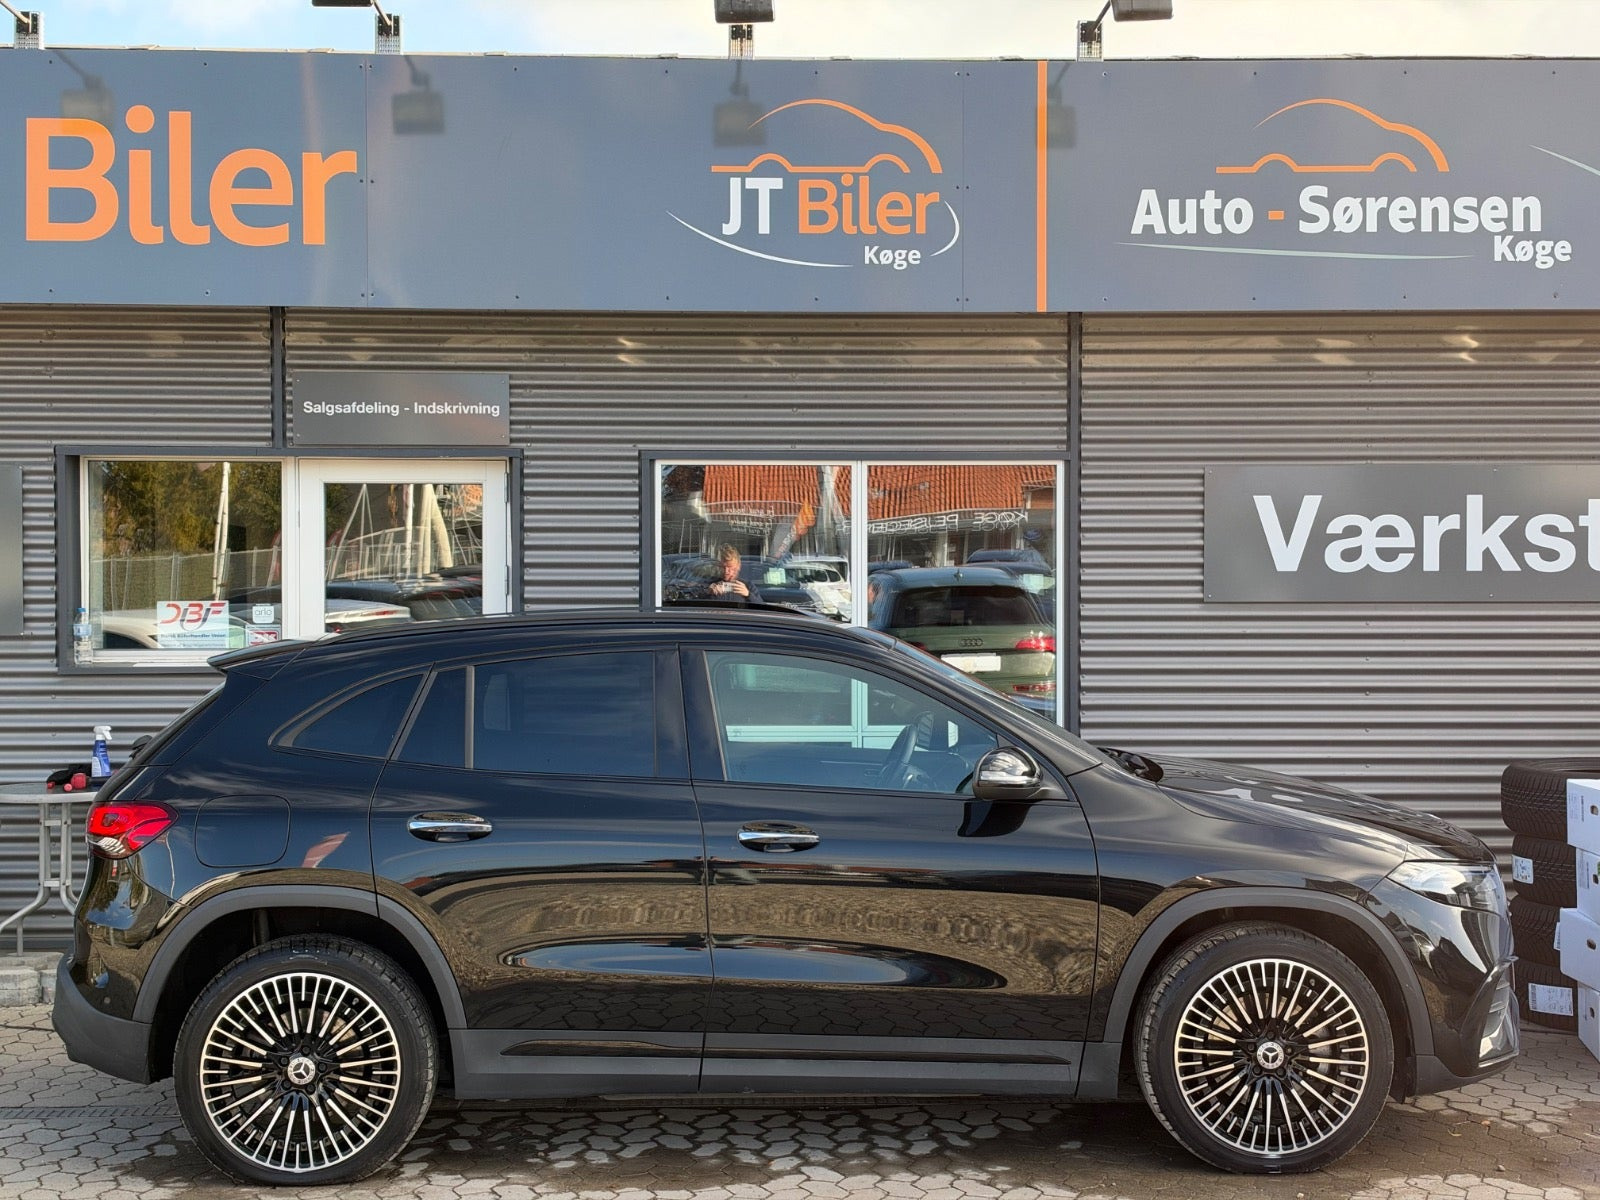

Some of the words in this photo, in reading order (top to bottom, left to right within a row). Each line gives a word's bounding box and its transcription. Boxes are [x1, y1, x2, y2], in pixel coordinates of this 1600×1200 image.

[25, 105, 358, 247] Biler
[722, 176, 784, 236] JT
[798, 173, 940, 235] Biler
[1130, 188, 1254, 235] Auto
[1268, 210, 1285, 221] -
[1298, 184, 1542, 234] Sørensen
[864, 245, 921, 270] Køge
[1493, 234, 1572, 270] Køge
[303, 400, 400, 417] Salgsafdeling
[413, 401, 501, 418] Indskrivning
[1252, 494, 1600, 573] Værkst
